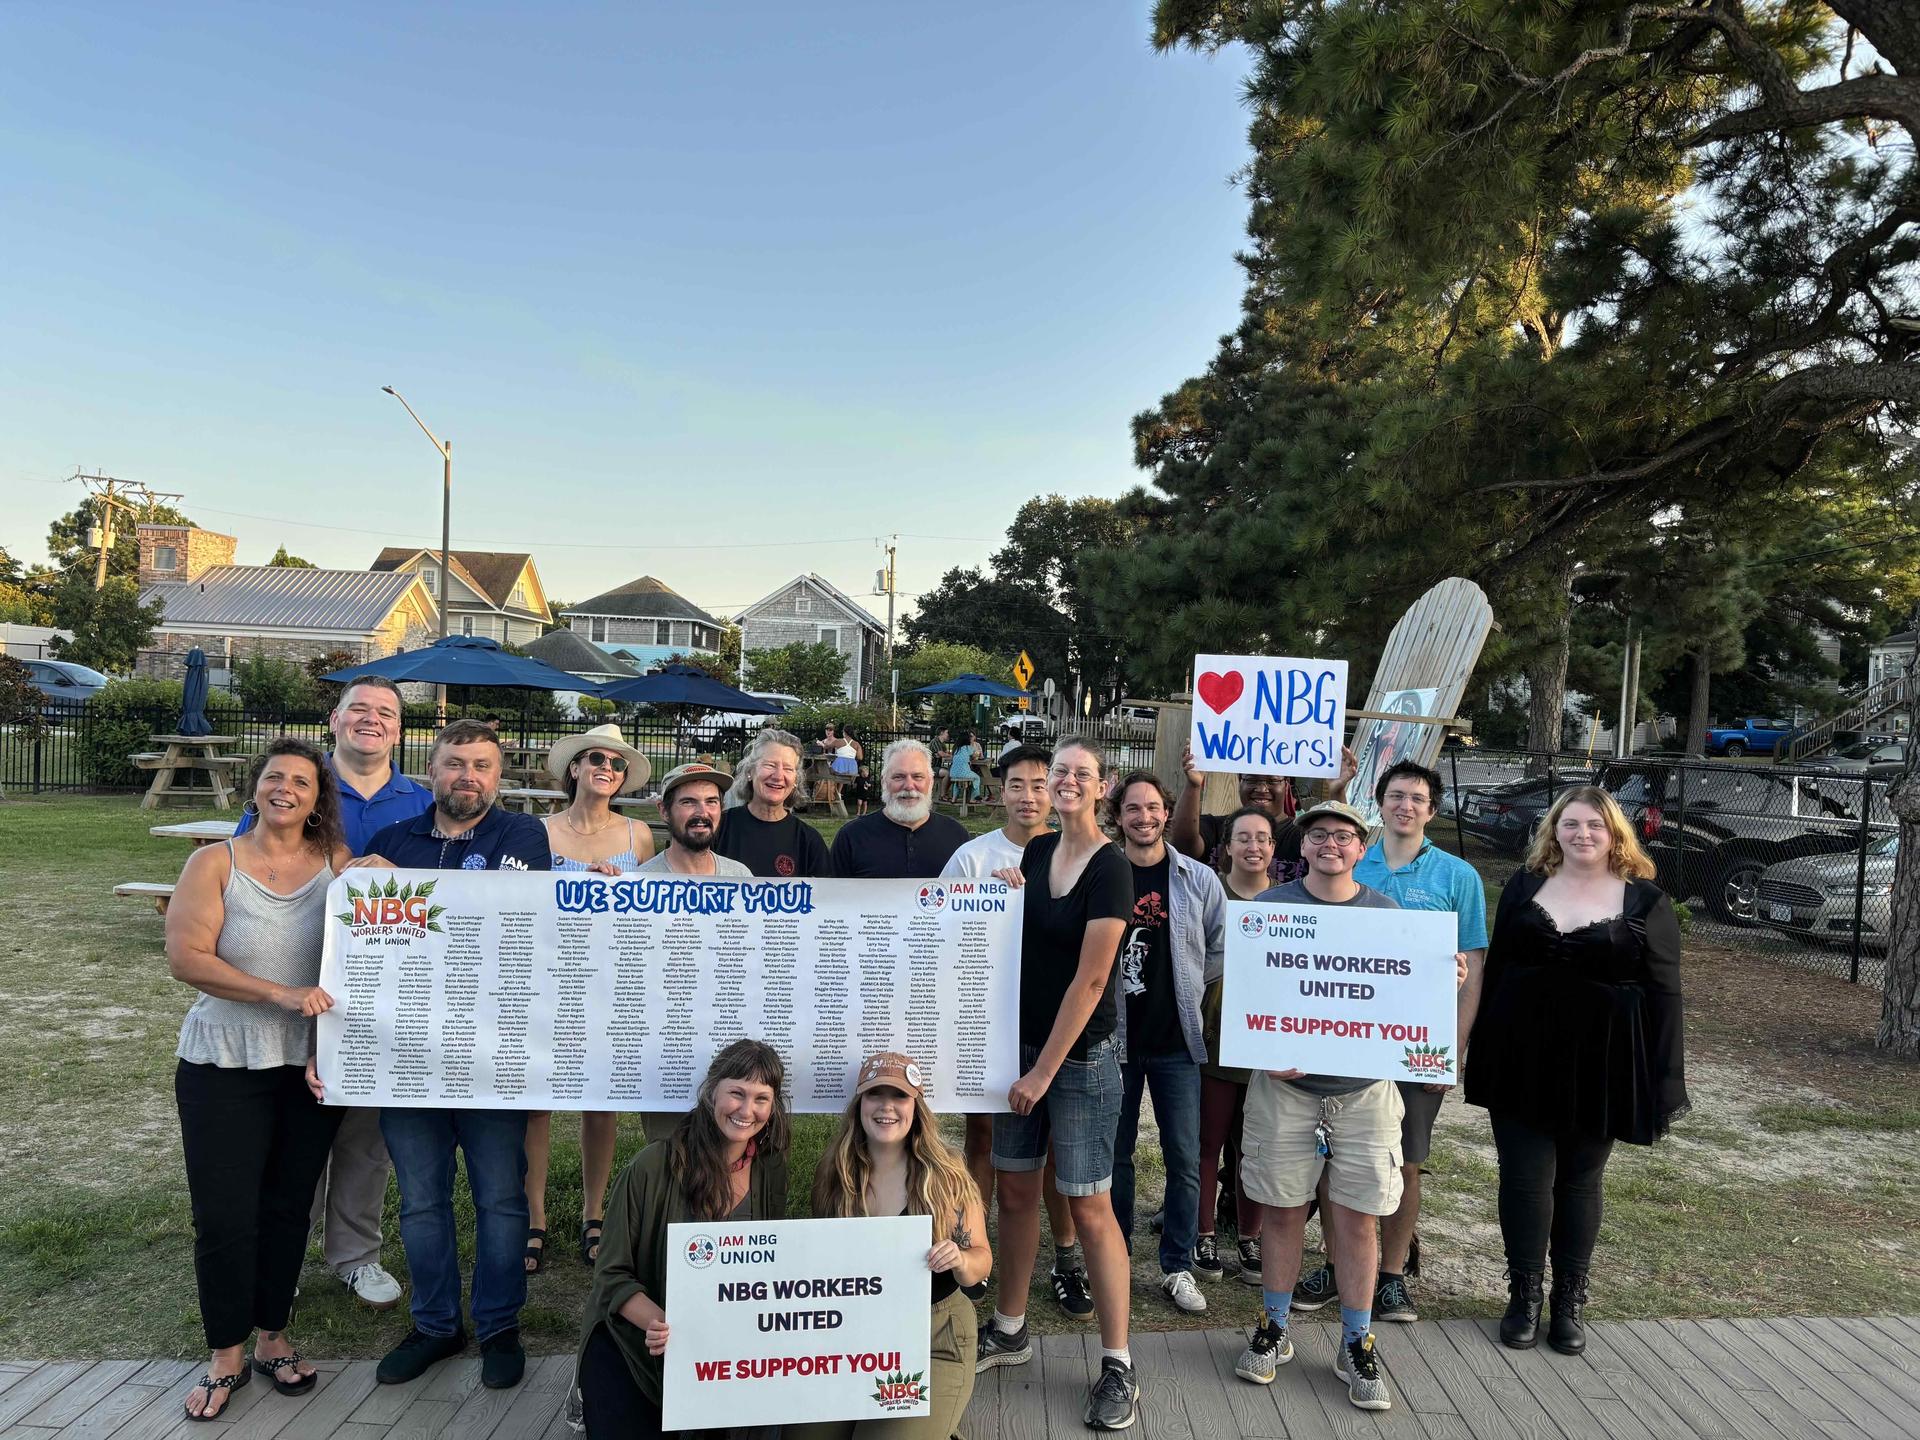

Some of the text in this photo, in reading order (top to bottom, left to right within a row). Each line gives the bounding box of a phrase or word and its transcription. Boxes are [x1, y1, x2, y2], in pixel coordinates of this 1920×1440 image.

[1254, 670, 1336, 730] NBG
[1197, 720, 1334, 768] Workers!
[556, 878, 816, 915] WE SUPPORT YOU!
[950, 884, 1008, 894] IAM NBG
[354, 897, 427, 928] NBG
[952, 899, 1005, 912] UNION
[1267, 914, 1317, 925] IAM NBG
[351, 926, 393, 937] WORKERS
[1268, 927, 1315, 939] UNION
[366, 938, 380, 946] IAM
[1266, 952, 1411, 975] NBG WORKERS
[1300, 980, 1375, 1000] UNITED
[1246, 1014, 1428, 1042] WE SUPPORT YOU!
[1408, 1054, 1445, 1070] NBG
[719, 1234, 777, 1247] IAM NBG
[721, 1250, 775, 1264] UNION
[718, 1276, 882, 1302] NBG WORKERS
[758, 1310, 843, 1332] UNITED
[695, 1352, 901, 1381] WE SUPPORT YOU!
[880, 1381, 919, 1399] NBG
